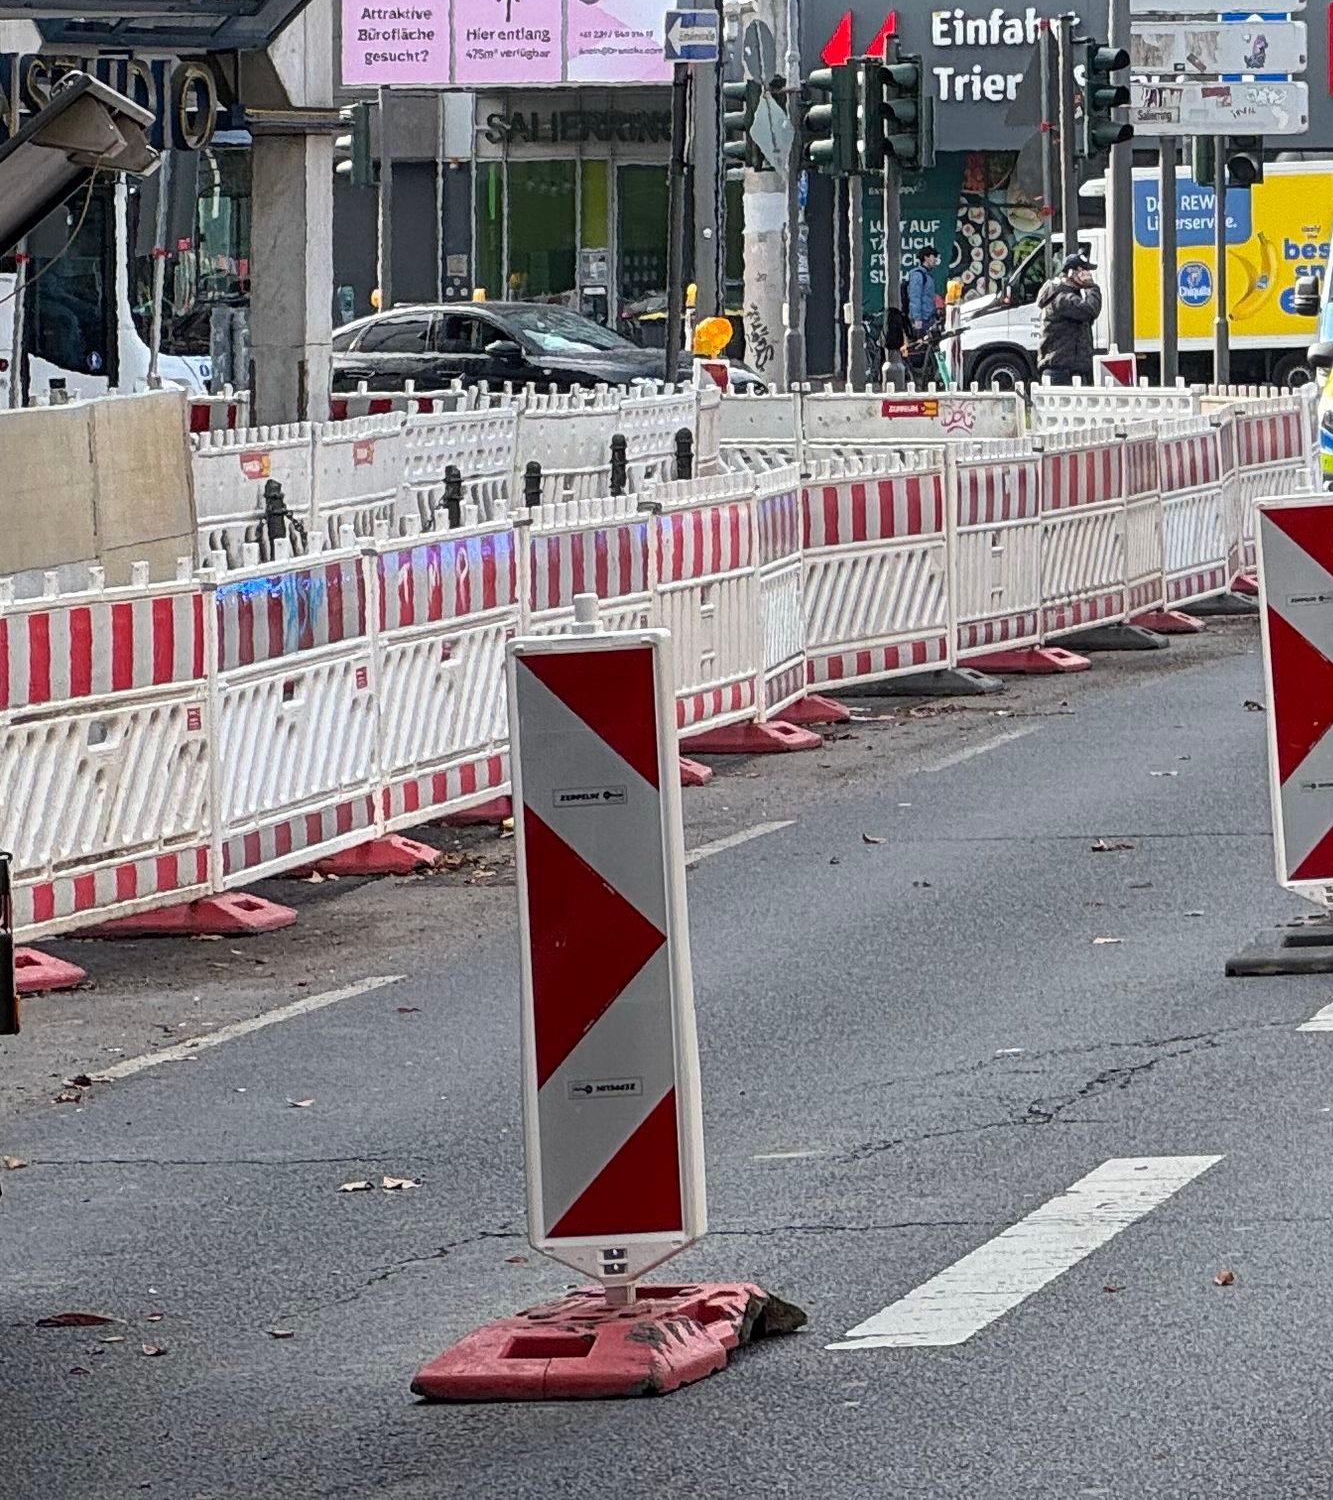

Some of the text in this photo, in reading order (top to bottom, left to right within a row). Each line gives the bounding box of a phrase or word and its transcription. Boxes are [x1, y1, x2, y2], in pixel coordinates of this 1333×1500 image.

[361, 7, 433, 20] Attraktive
[357, 27, 435, 41] Bürofläche
[466, 27, 551, 43] Hier entlang
[364, 50, 430, 66] gesucht?
[909, 220, 940, 232] AUF
